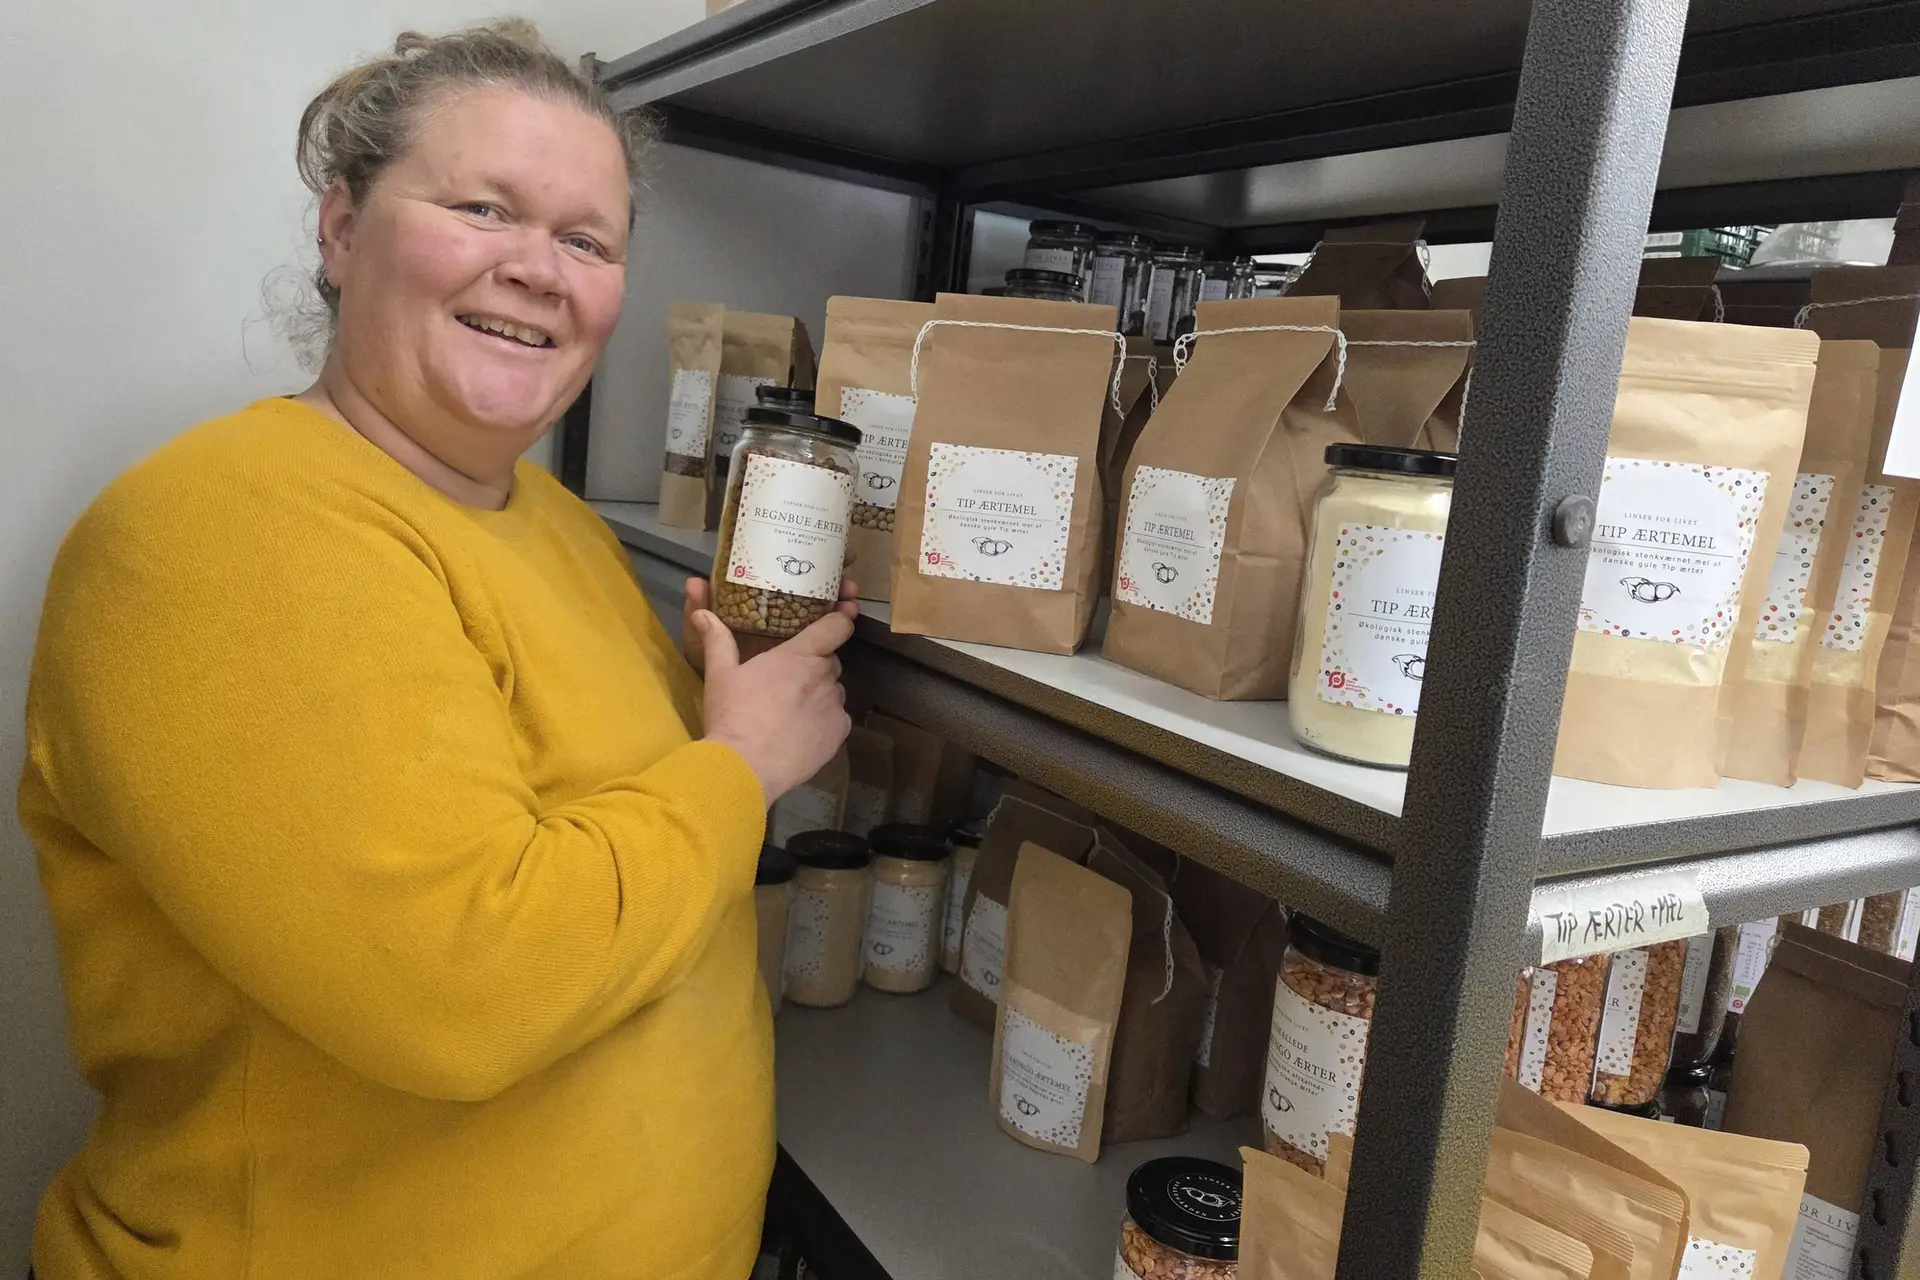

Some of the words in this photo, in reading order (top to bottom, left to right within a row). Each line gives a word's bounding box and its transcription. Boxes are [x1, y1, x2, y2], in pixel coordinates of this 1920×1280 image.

[877, 436, 908, 449] ÆRTE
[957, 498, 976, 509] TIP
[979, 501, 1037, 516] ÆRTEMEL
[754, 507, 812, 527] REGNBUE
[813, 519, 844, 534] ÆRTER
[1624, 512, 1653, 521] LINSER
[1674, 518, 1698, 526] LIVET
[1143, 521, 1156, 533] TIP
[1157, 524, 1195, 541] ÆRTEMEL
[1599, 524, 1627, 538] TIP
[1632, 529, 1717, 549] ÆRTEMEL
[1602, 557, 1634, 566] danske
[1638, 561, 1657, 570] gule
[1662, 563, 1676, 571] Tip
[1680, 566, 1704, 575] ærter
[1635, 552, 1691, 564] stenkværnet
[1396, 588, 1424, 596] LINSER
[1371, 599, 1399, 614] TIP
[1403, 604, 1435, 619] ÆR
[1358, 621, 1402, 633] Økologisk
[1374, 633, 1406, 643] danske
[1544, 911, 1578, 944] TIP
[1583, 900, 1645, 944] ÆRTER
[1293, 1057, 1336, 1083] ÆRTER
[1800, 1202, 1819, 1219] OR
[1828, 1214, 1857, 1231] LIV
